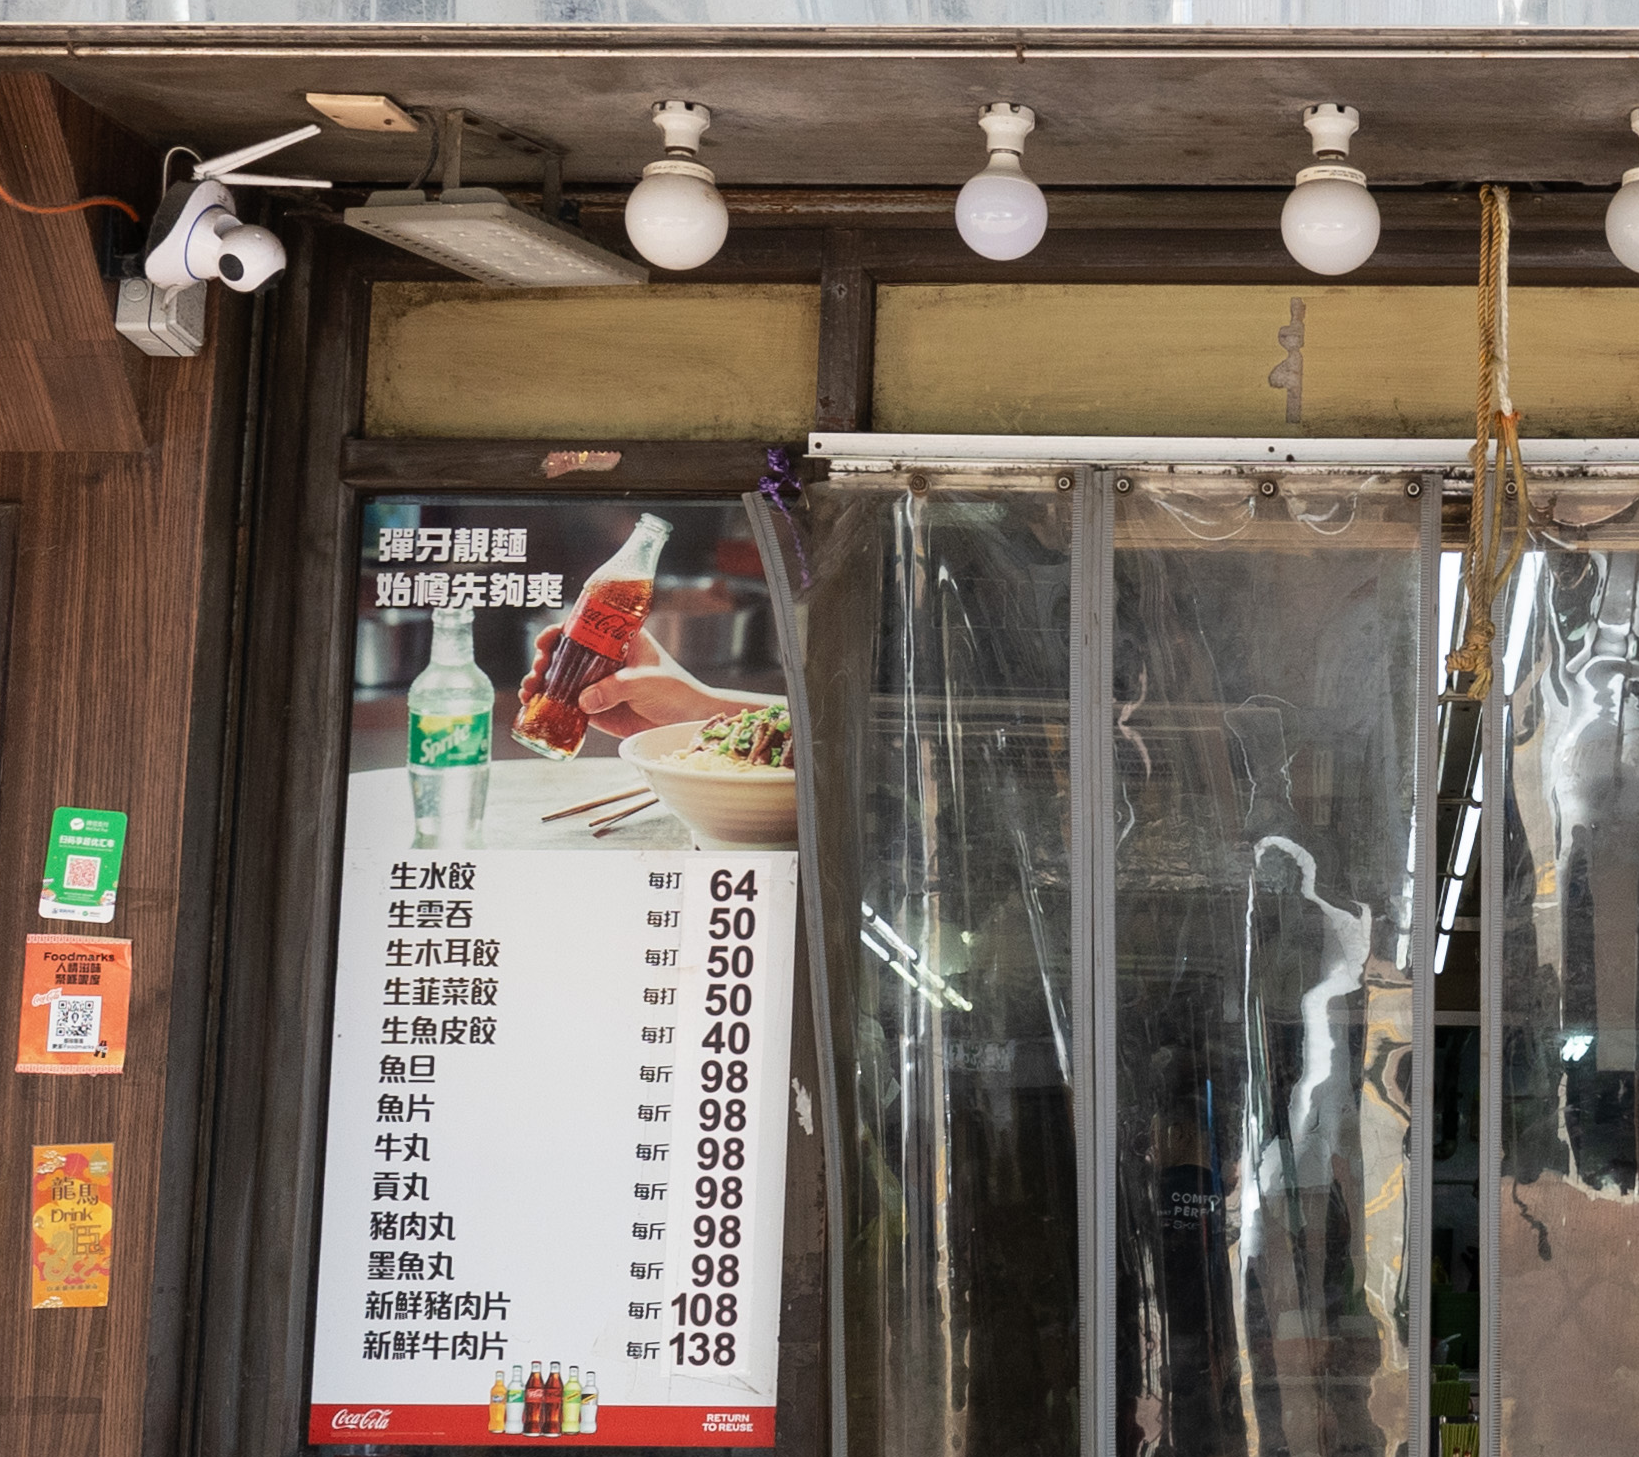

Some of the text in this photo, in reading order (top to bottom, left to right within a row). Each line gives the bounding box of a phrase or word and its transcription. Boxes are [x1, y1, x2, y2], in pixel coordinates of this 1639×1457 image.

[377, 527, 528, 564] 彈牙靚麵
[375, 572, 564, 609] 始樽先夠爽
[390, 862, 758, 902] 生水餃 每打 64
[387, 900, 756, 941] 生雲吞 50
[43, 951, 115, 962] Foodmarks
[385, 939, 754, 979] 生木耳餃 50
[704, 983, 753, 1017] 50
[381, 1016, 751, 1055] 生魚皮餃 40
[378, 1054, 749, 1094] 魚旦 98
[50, 1207, 93, 1223] Drink
[364, 1290, 738, 1328] 新鮮豬肉片 108
[362, 1330, 736, 1366] 新鮮牛肉片 138
[331, 1408, 393, 1430] Coca-Cola
